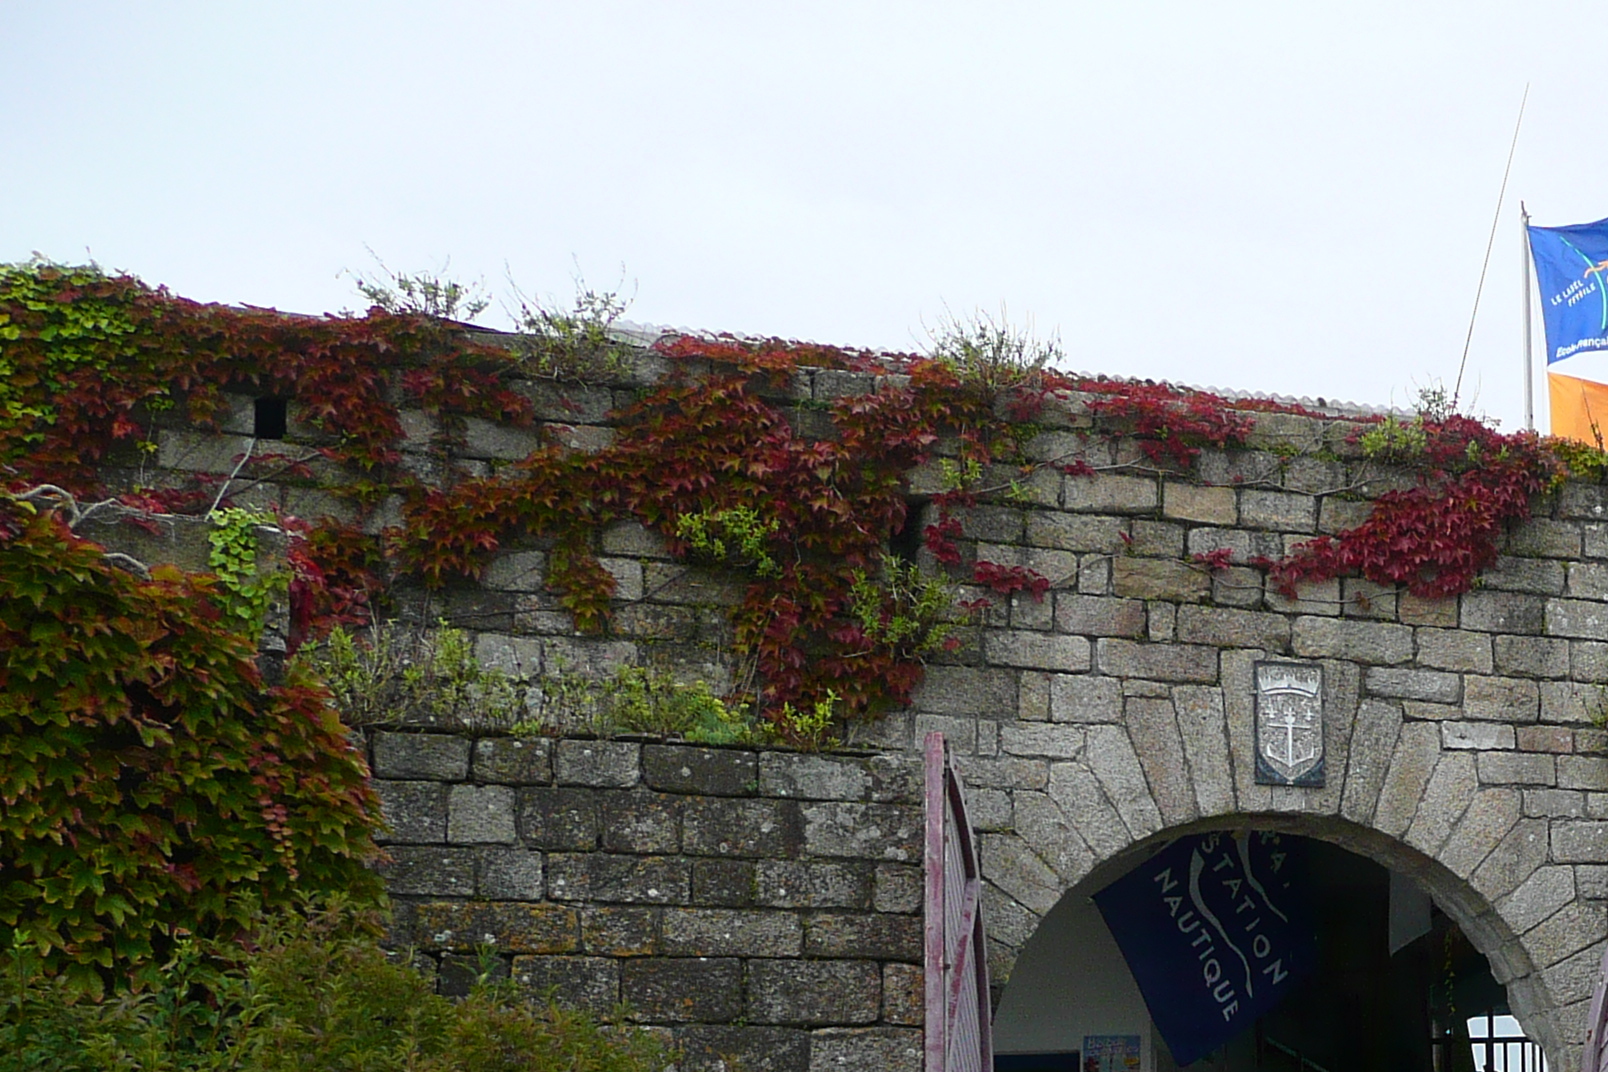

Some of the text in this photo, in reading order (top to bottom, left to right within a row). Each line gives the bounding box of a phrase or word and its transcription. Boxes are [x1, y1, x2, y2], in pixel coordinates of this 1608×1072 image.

[1551, 279, 1585, 306] LE LABEL
[1153, 867, 1240, 1022] NAUTIQUE
[1202, 832, 1289, 986] STATION
